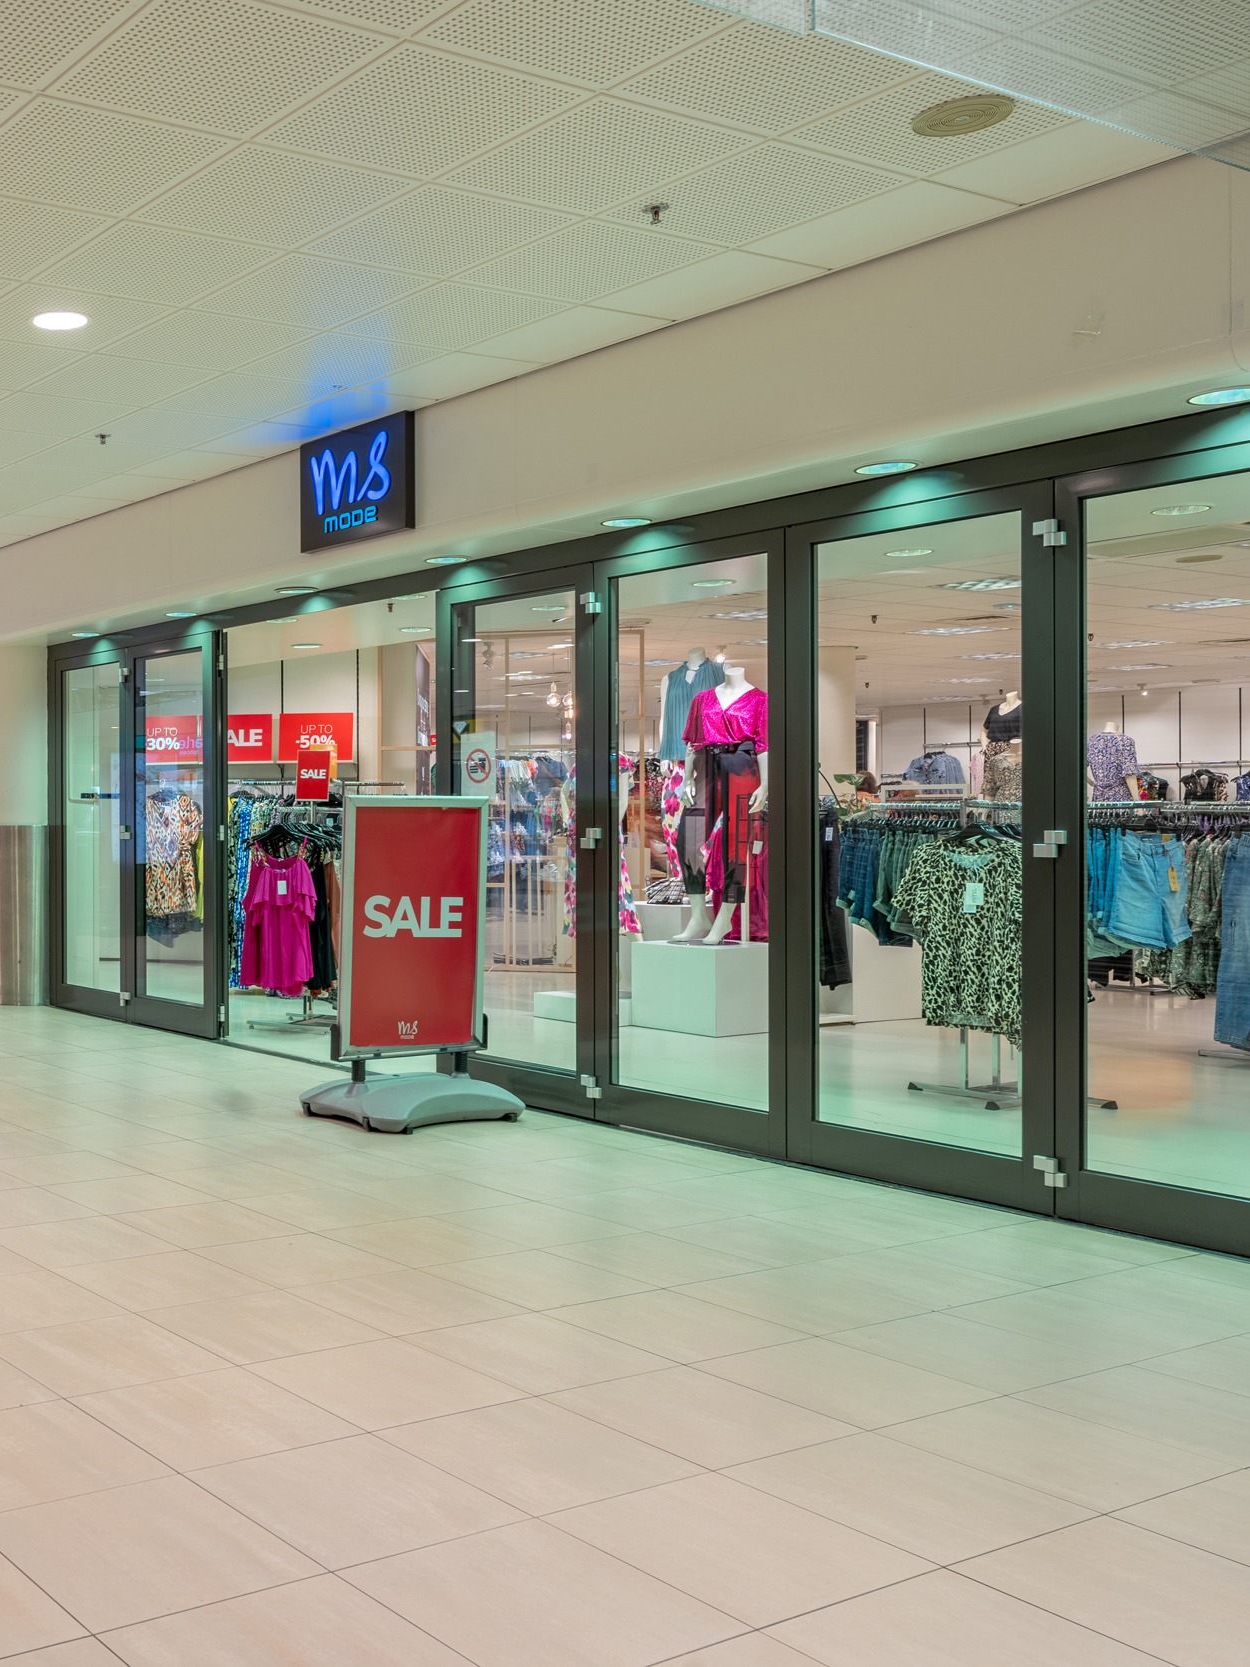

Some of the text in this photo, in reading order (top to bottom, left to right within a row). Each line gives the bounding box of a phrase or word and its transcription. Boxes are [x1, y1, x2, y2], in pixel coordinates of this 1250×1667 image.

[147, 727, 178, 737] UP TO
[300, 724, 333, 735] UP TO
[295, 735, 335, 749] -50%
[300, 768, 327, 779] SALE
[363, 895, 464, 938] SALE
